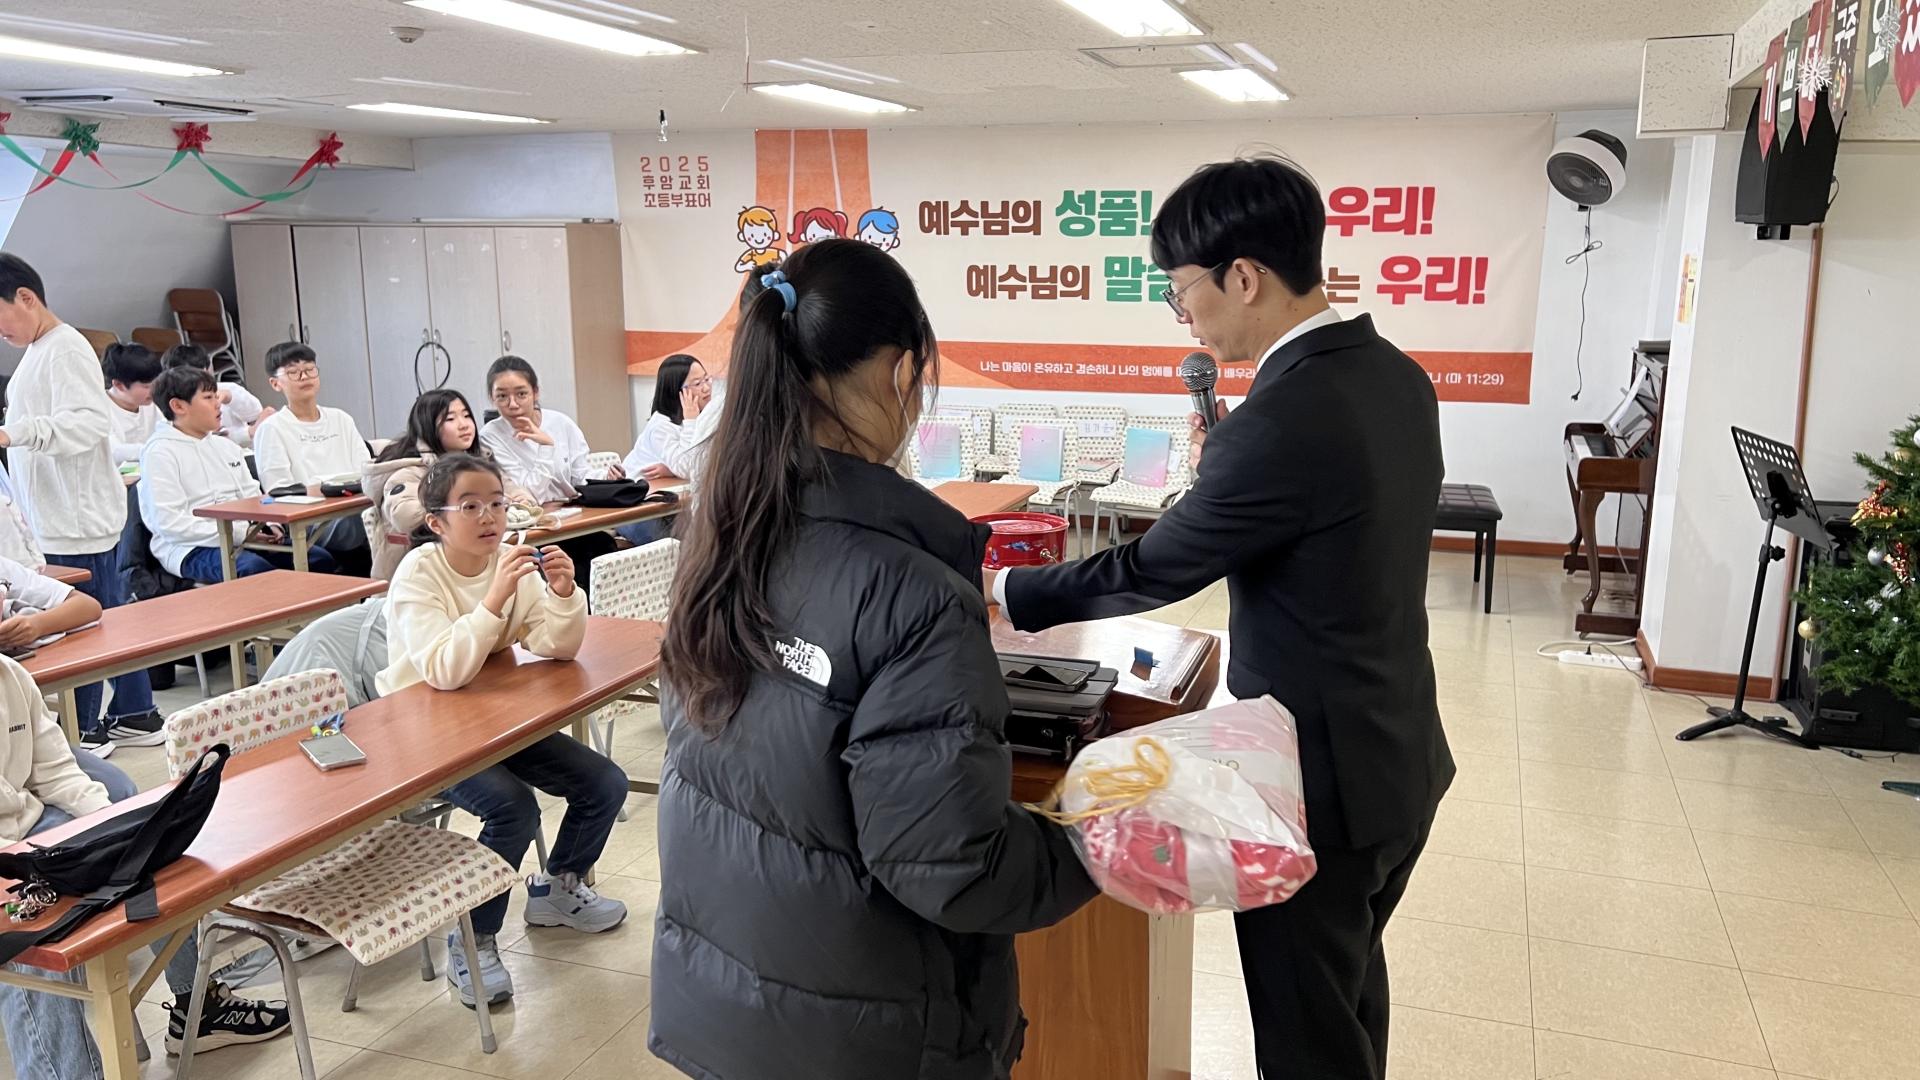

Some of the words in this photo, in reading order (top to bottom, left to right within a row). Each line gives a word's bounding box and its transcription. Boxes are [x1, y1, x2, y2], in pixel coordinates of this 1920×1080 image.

[640, 156, 709, 172] 2025
[643, 192, 711, 208] 초등부표어
[919, 200, 1042, 236] 예수님의
[1055, 190, 1153, 237] 성품!
[1325, 186, 1436, 237] 우리!
[967, 264, 1091, 300] 예수님의
[1376, 256, 1489, 305] 우리!
[980, 361, 1000, 373] 나는
[1002, 362, 1031, 373] 마음이
[1034, 363, 1073, 374] 온유하고
[1076, 363, 1116, 375] 겸손하니
[1118, 364, 1139, 375] 나의
[1446, 372, 1462, 384] (마
[1466, 373, 1504, 385] 11:29)
[775, 640, 813, 667] NORTH
[794, 636, 815, 655] THE
[782, 656, 811, 677] FACE
